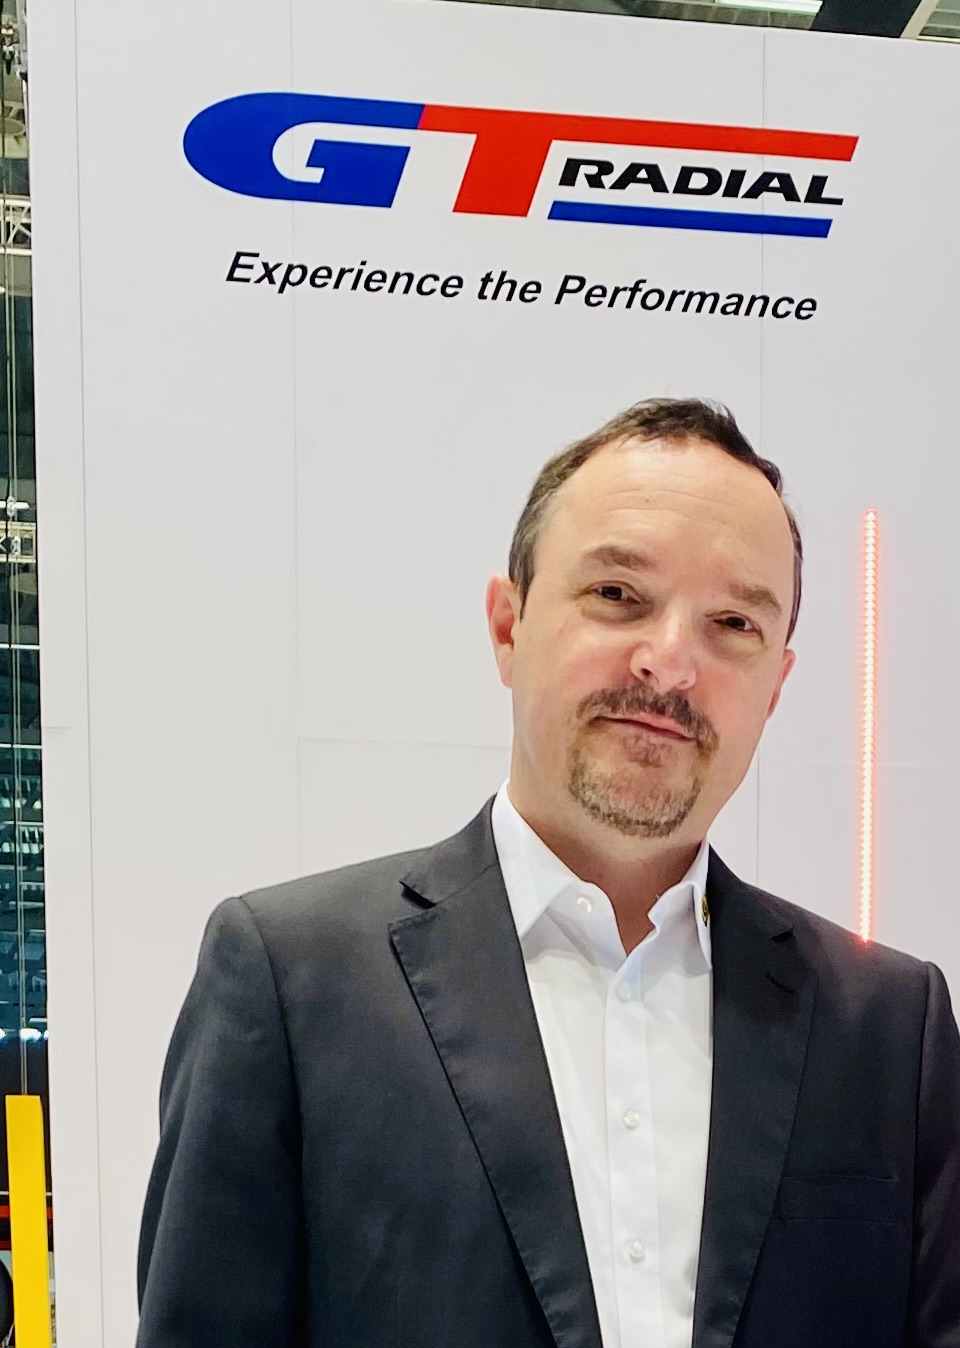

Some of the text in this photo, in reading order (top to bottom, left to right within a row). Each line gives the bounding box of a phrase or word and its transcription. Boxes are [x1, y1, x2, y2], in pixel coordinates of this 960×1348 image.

[183, 92, 858, 218] GT RADIAL
[225, 250, 818, 321] Experience the Performance
